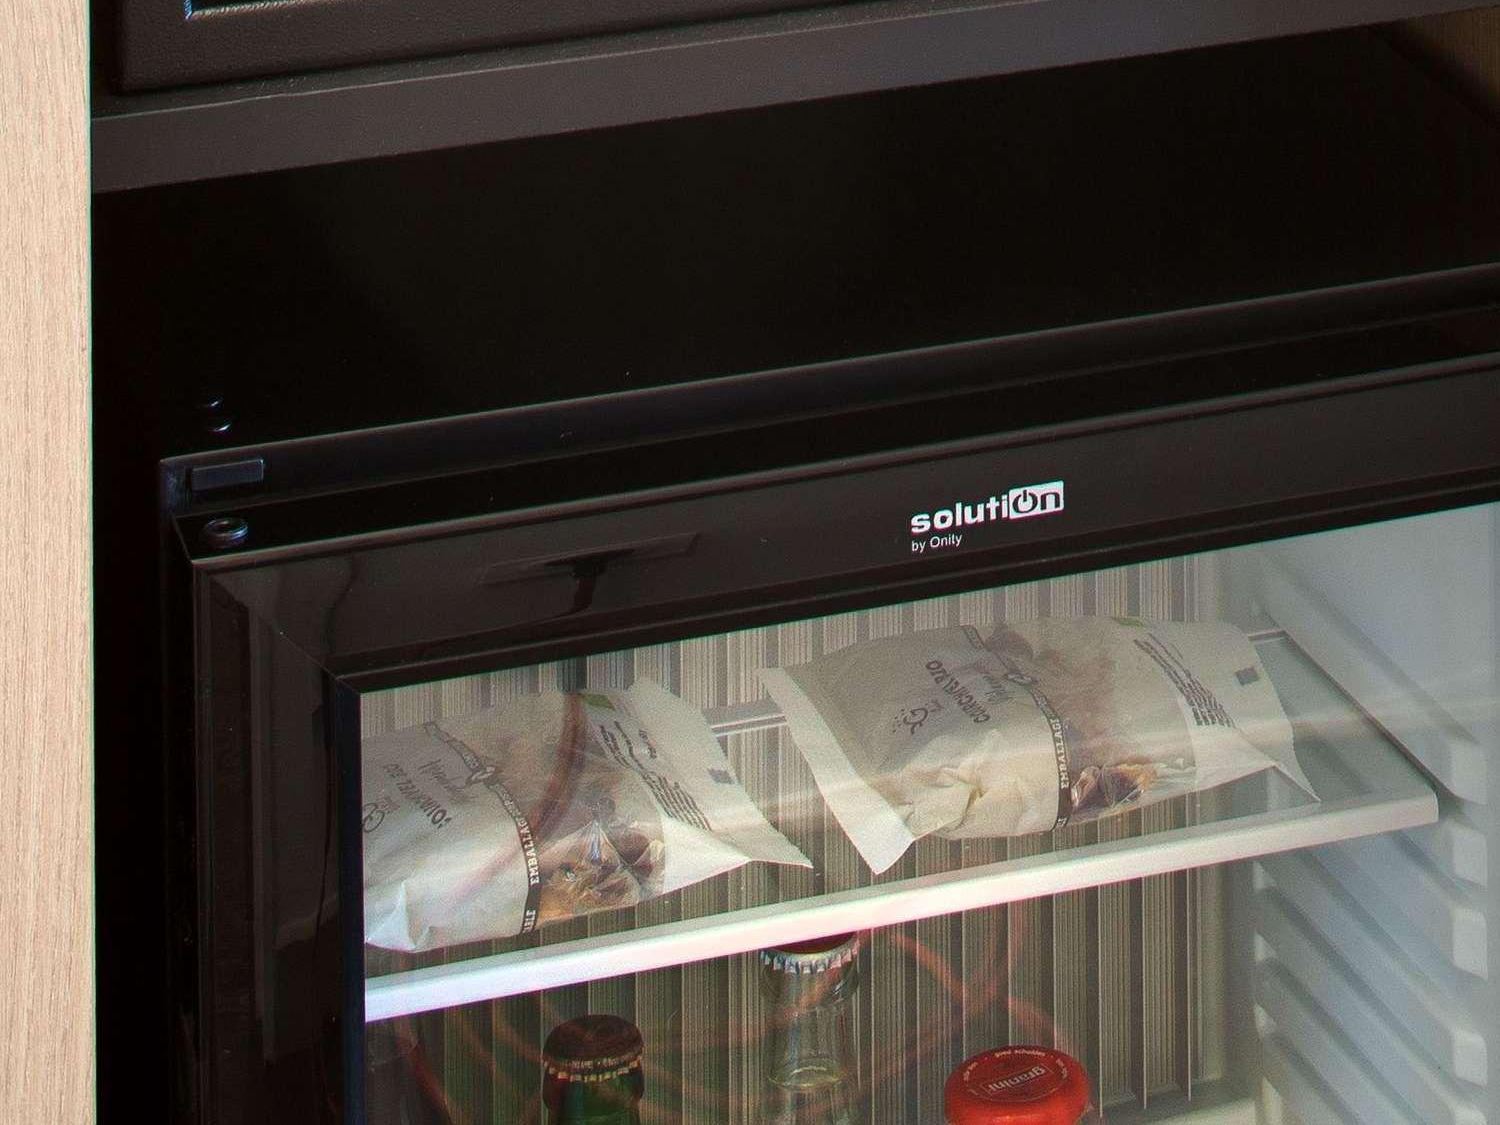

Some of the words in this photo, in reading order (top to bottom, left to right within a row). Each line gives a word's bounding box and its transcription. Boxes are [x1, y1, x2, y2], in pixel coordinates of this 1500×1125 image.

[911, 481, 1064, 533] solution
[911, 539, 926, 553] by
[987, 1066, 1046, 1092] granini
